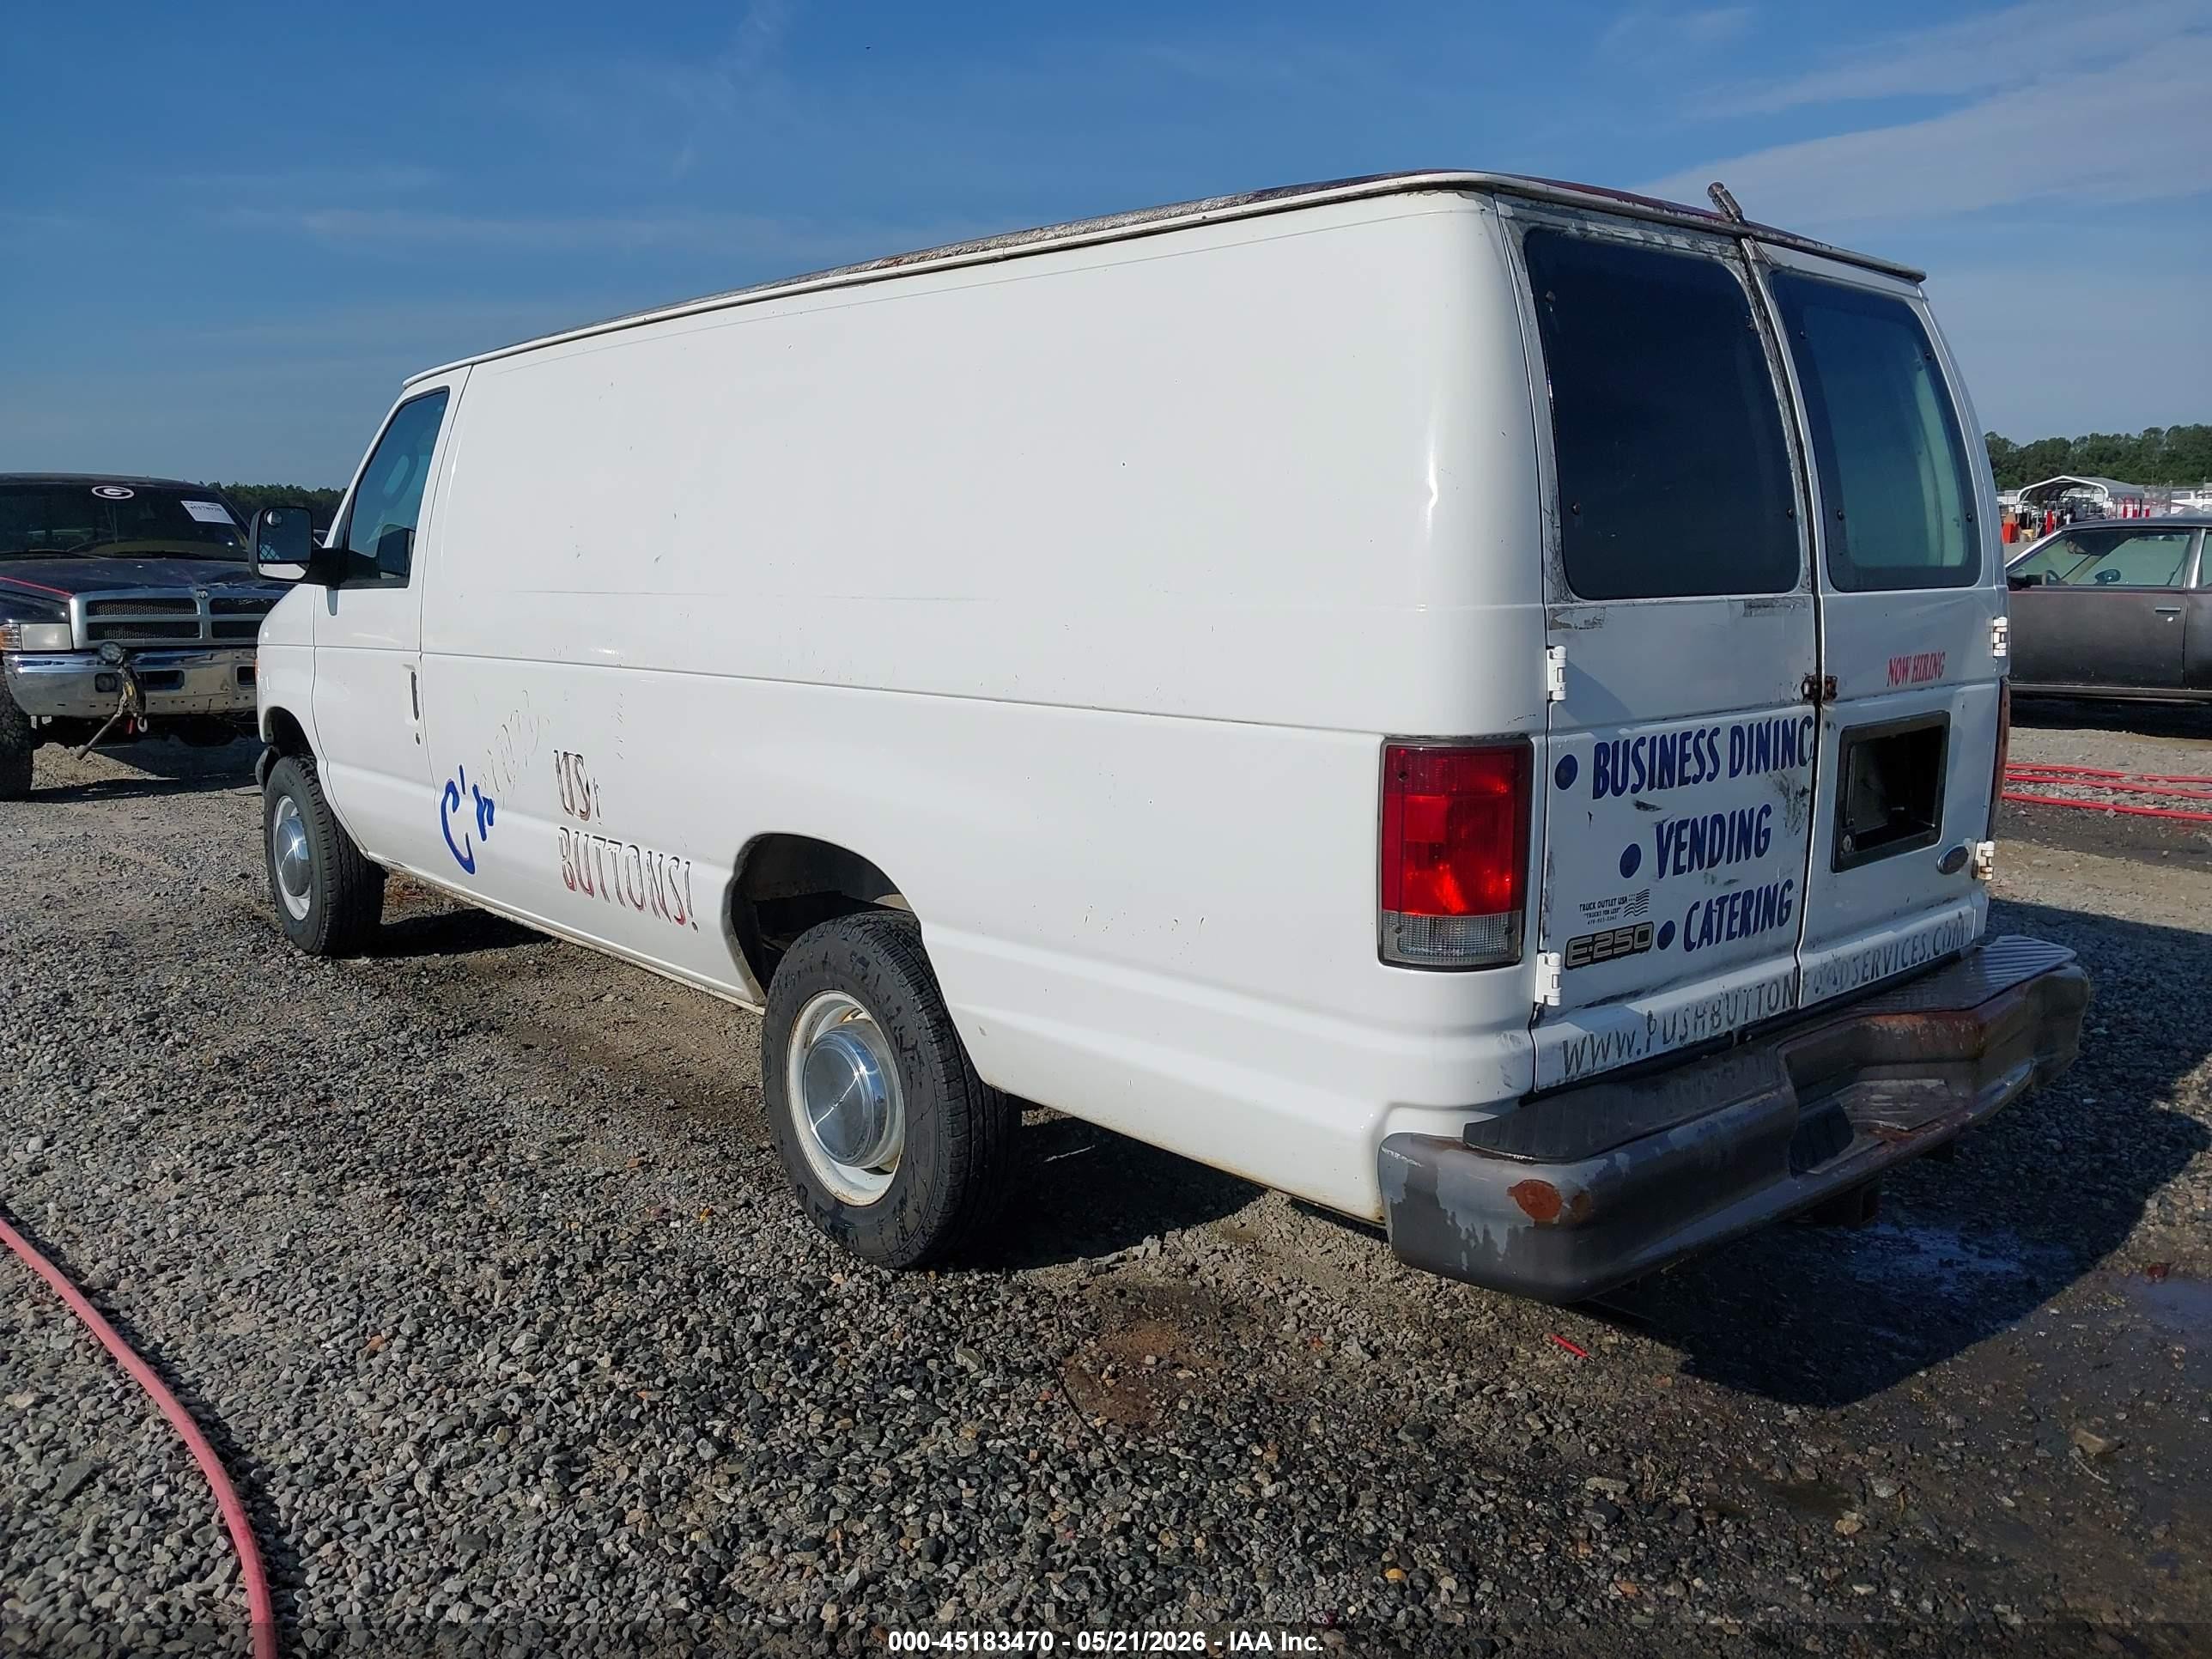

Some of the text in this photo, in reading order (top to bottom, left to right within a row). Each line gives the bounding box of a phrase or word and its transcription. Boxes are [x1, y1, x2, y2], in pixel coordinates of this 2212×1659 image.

[1887, 651, 1946, 687] NOW HIRING
[1592, 726, 1721, 800] BUSINESS
[1656, 804, 1772, 880] VENDING
[558, 826, 699, 934] BUTTONS!
[1579, 896, 1628, 912] TRUCK OUTLET USA
[1683, 878, 1794, 952] CATERING
[1566, 922, 1652, 968] E-250
